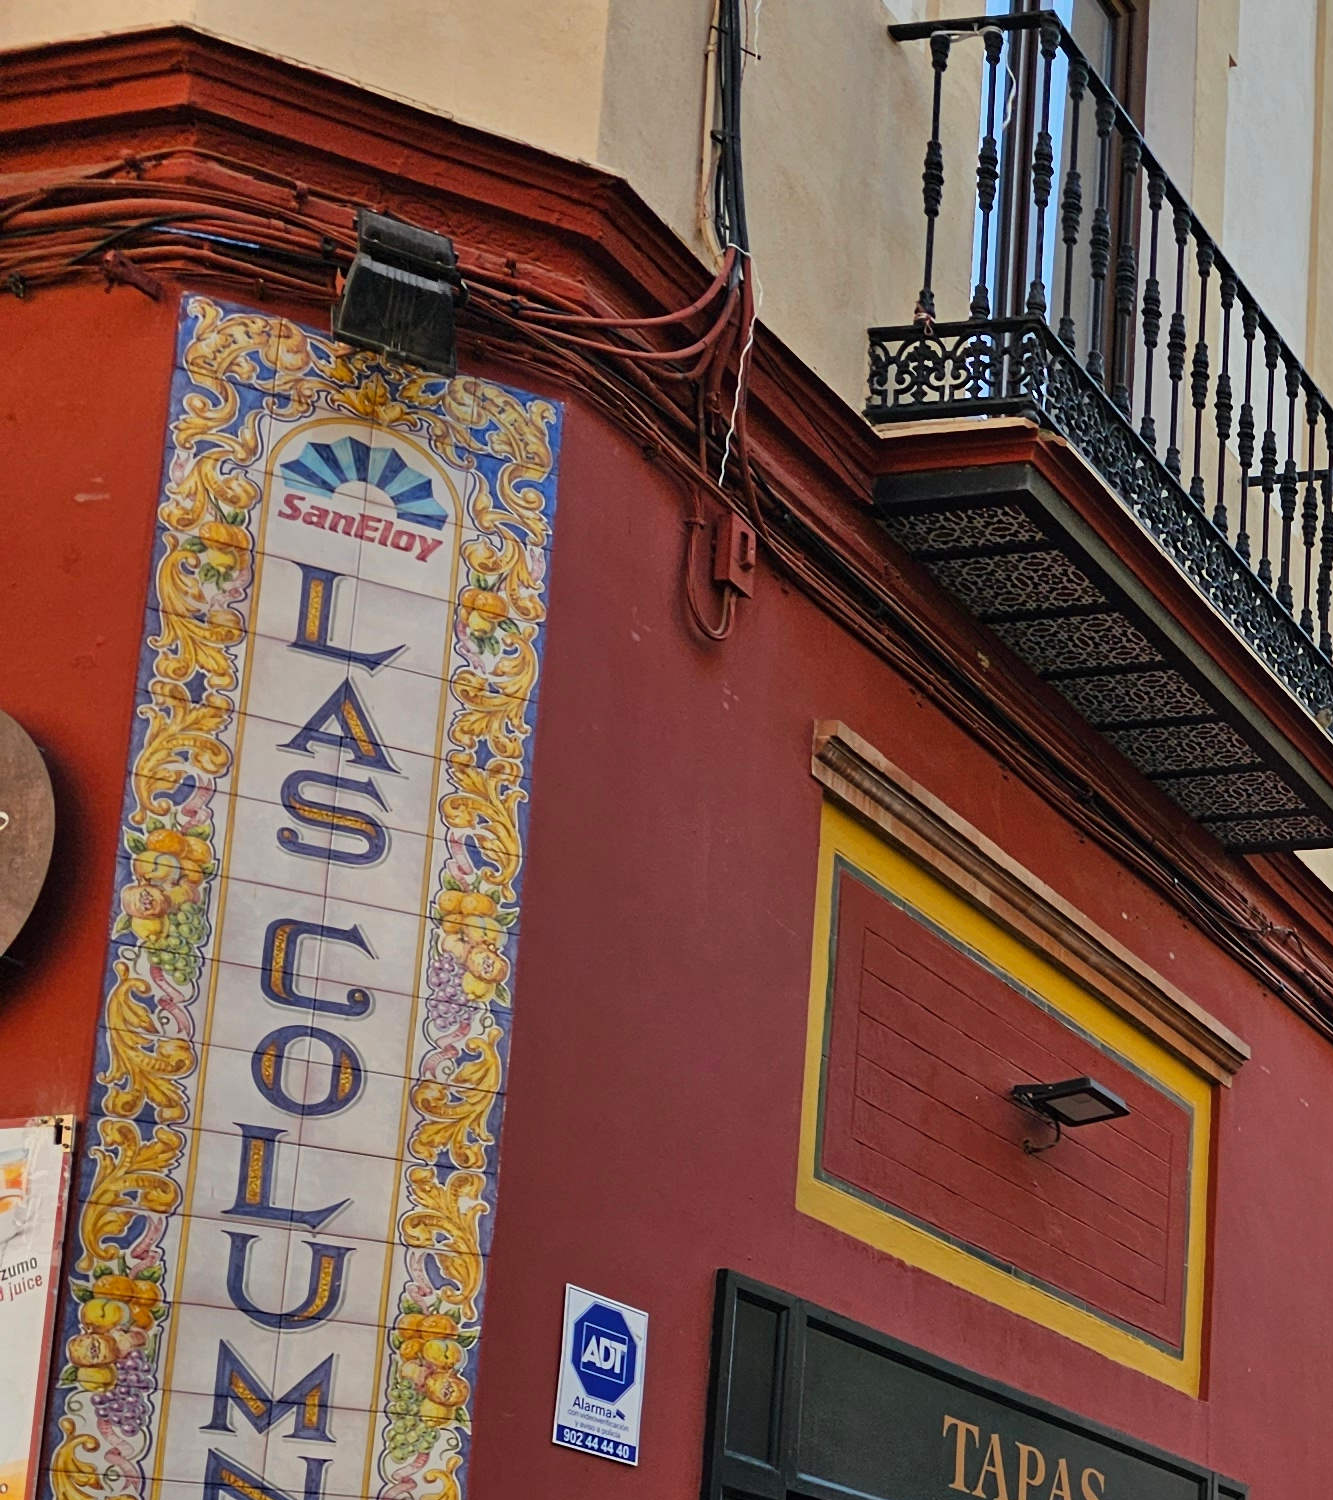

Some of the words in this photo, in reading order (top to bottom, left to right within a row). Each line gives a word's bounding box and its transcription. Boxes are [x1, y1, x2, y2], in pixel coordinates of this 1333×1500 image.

[275, 560, 407, 868] LAS
[0, 1257, 38, 1281] zumo
[8, 1274, 43, 1301] juice
[581, 1335, 627, 1374] ADT
[563, 1429, 583, 1446] 902
[585, 1435, 599, 1450] 44
[600, 1440, 614, 1454] 44
[616, 1444, 630, 1459] 40
